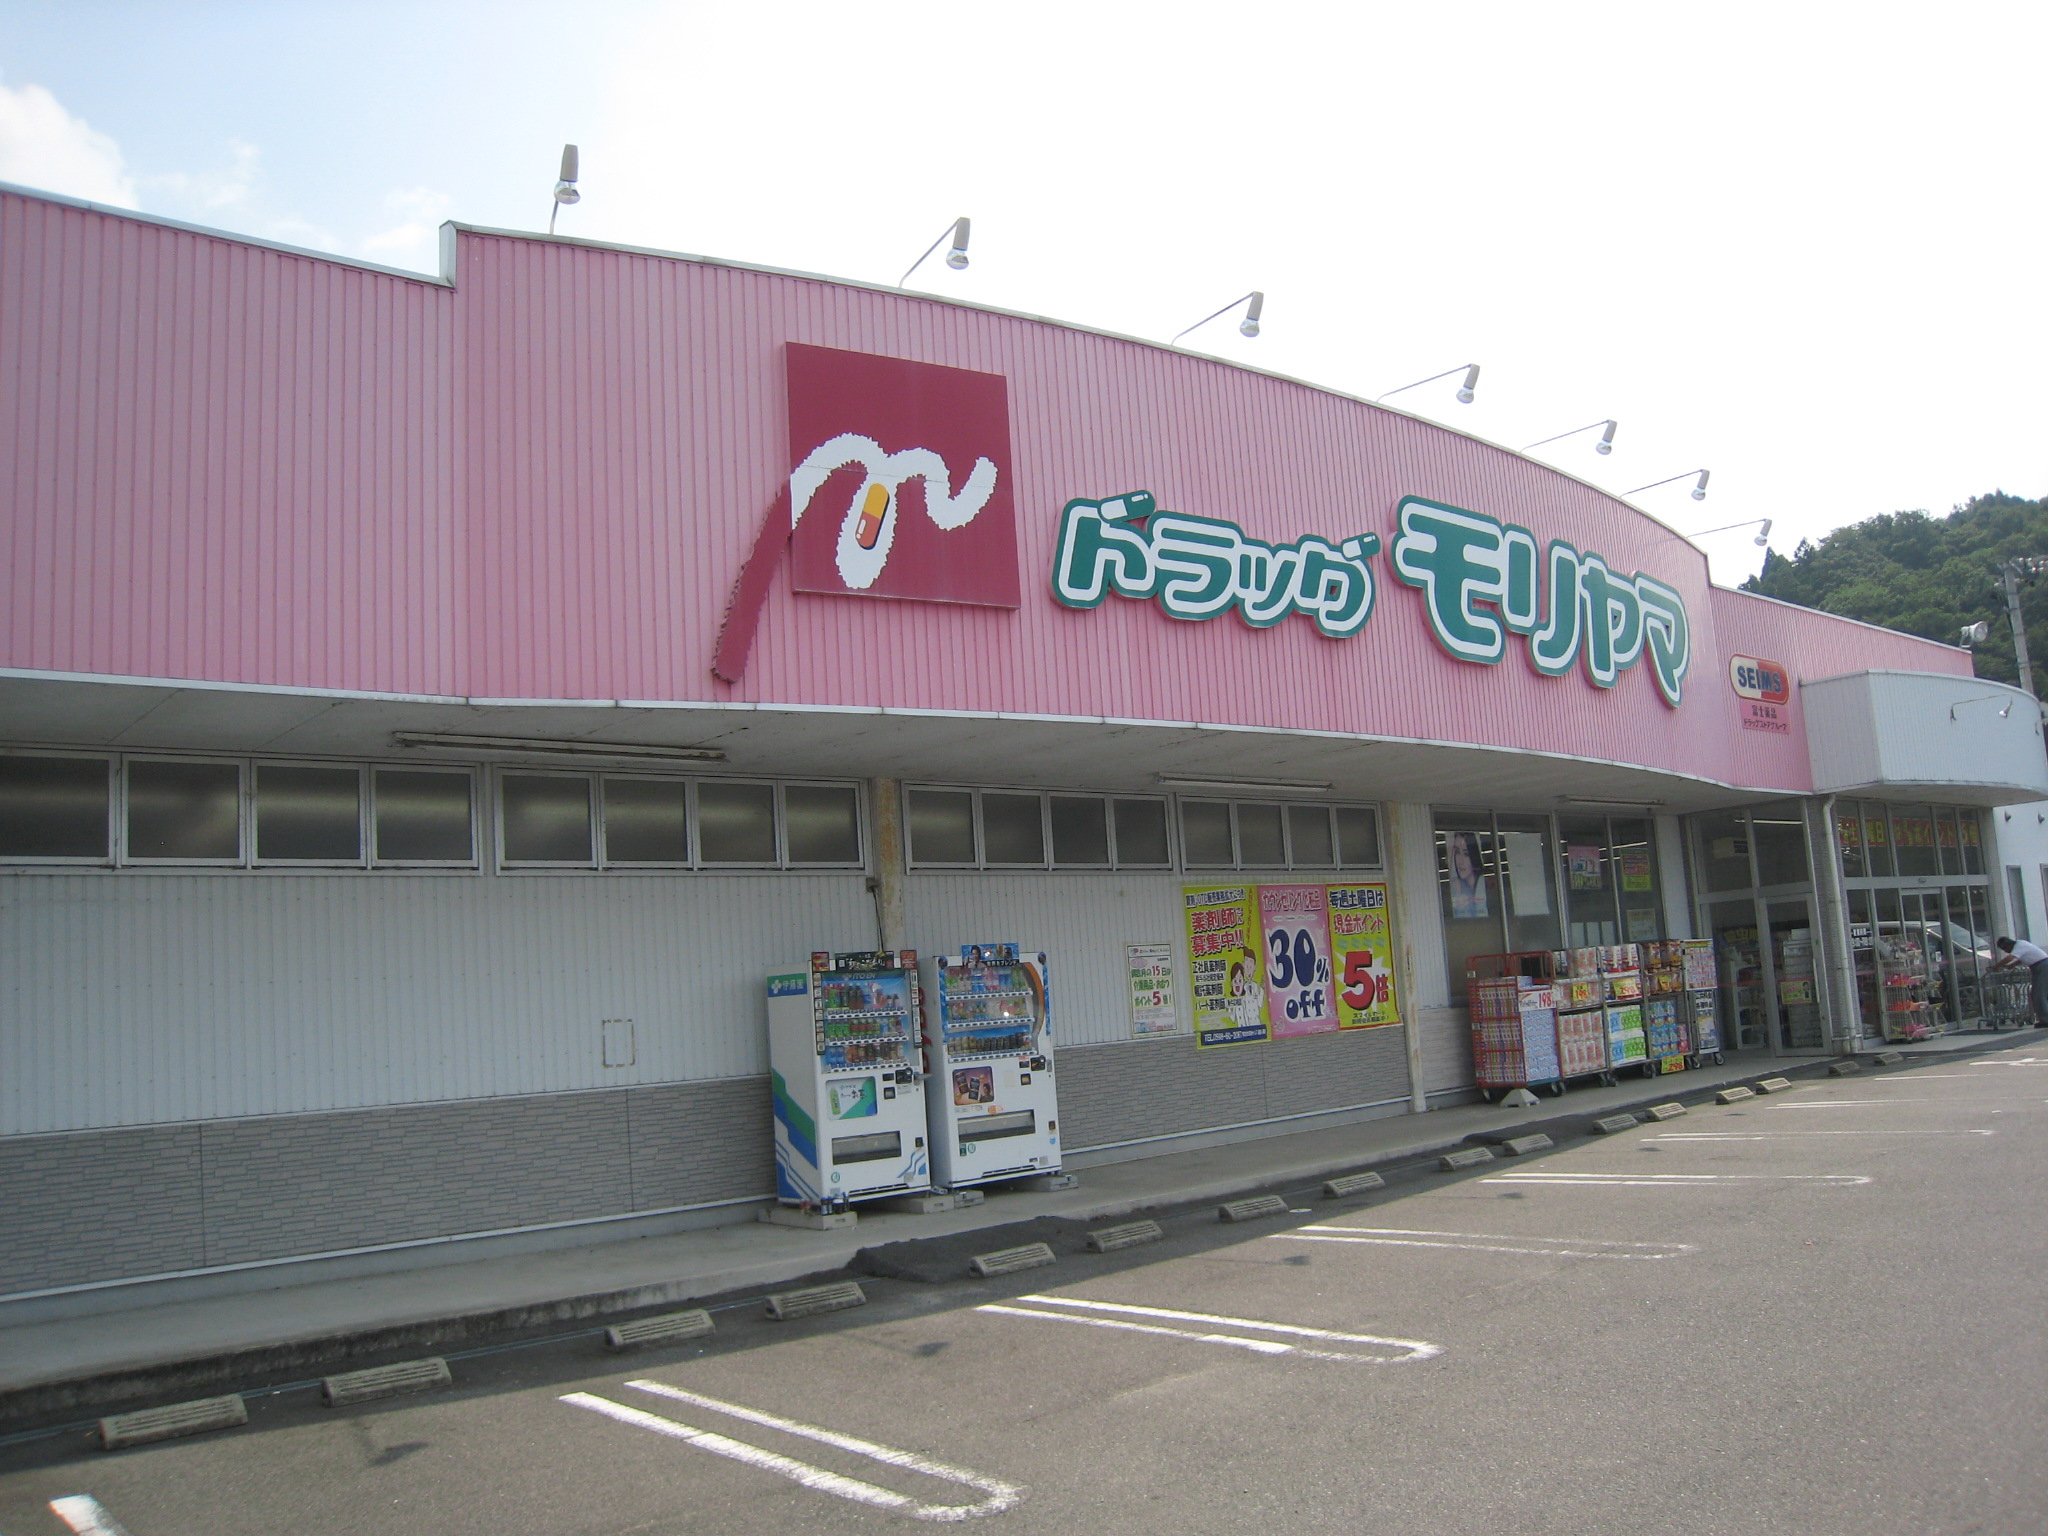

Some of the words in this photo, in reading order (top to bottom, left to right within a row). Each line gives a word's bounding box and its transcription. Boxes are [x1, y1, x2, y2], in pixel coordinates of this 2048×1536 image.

[1052, 490, 1381, 639] ドラッグ
[1392, 494, 1690, 707] モリヤマ
[1737, 665, 1783, 693] SEIMS
[1329, 889, 1384, 910] 毎週土曜日は
[1333, 913, 1385, 935] 現金ポイント
[1269, 929, 1330, 988] 30%
[1342, 950, 1389, 1010] 5倍
[1286, 989, 1325, 1019] off
